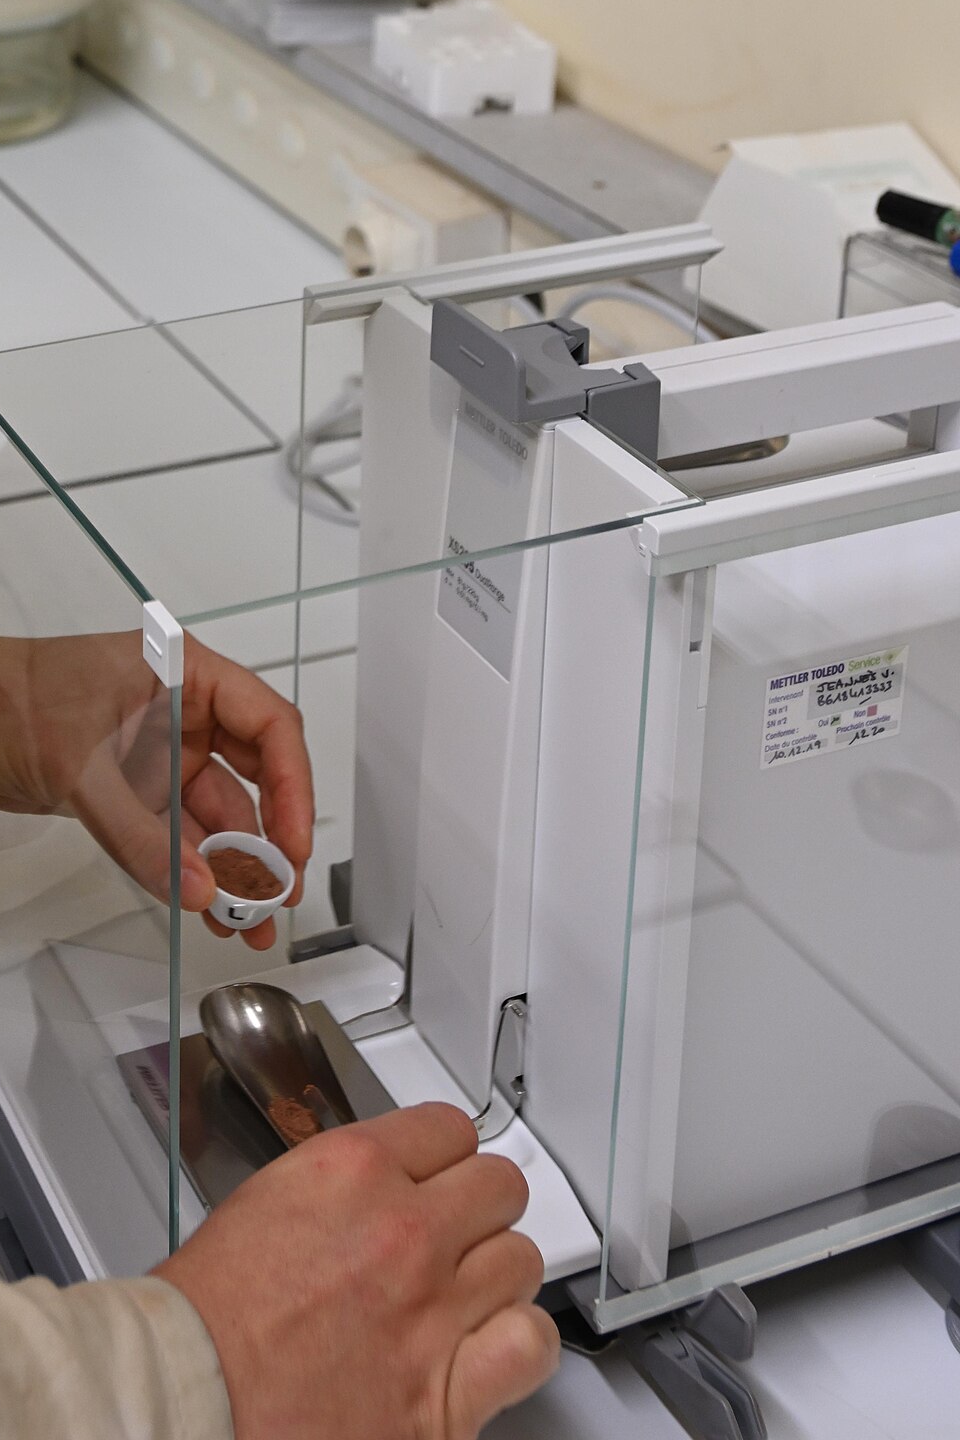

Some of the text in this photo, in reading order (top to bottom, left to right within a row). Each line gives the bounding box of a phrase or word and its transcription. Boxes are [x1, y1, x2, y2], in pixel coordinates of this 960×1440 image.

[770, 656, 881, 691] METTLER TOLEDO Service
[768, 690, 804, 704] Intervenant
[768, 708, 776, 716] SN
[853, 709, 867, 718] Non
[767, 720, 776, 728] SN
[818, 719, 830, 728] Oui
[836, 721, 865, 734] Prochain
[764, 743, 780, 753] Date
[781, 739, 791, 748] du
